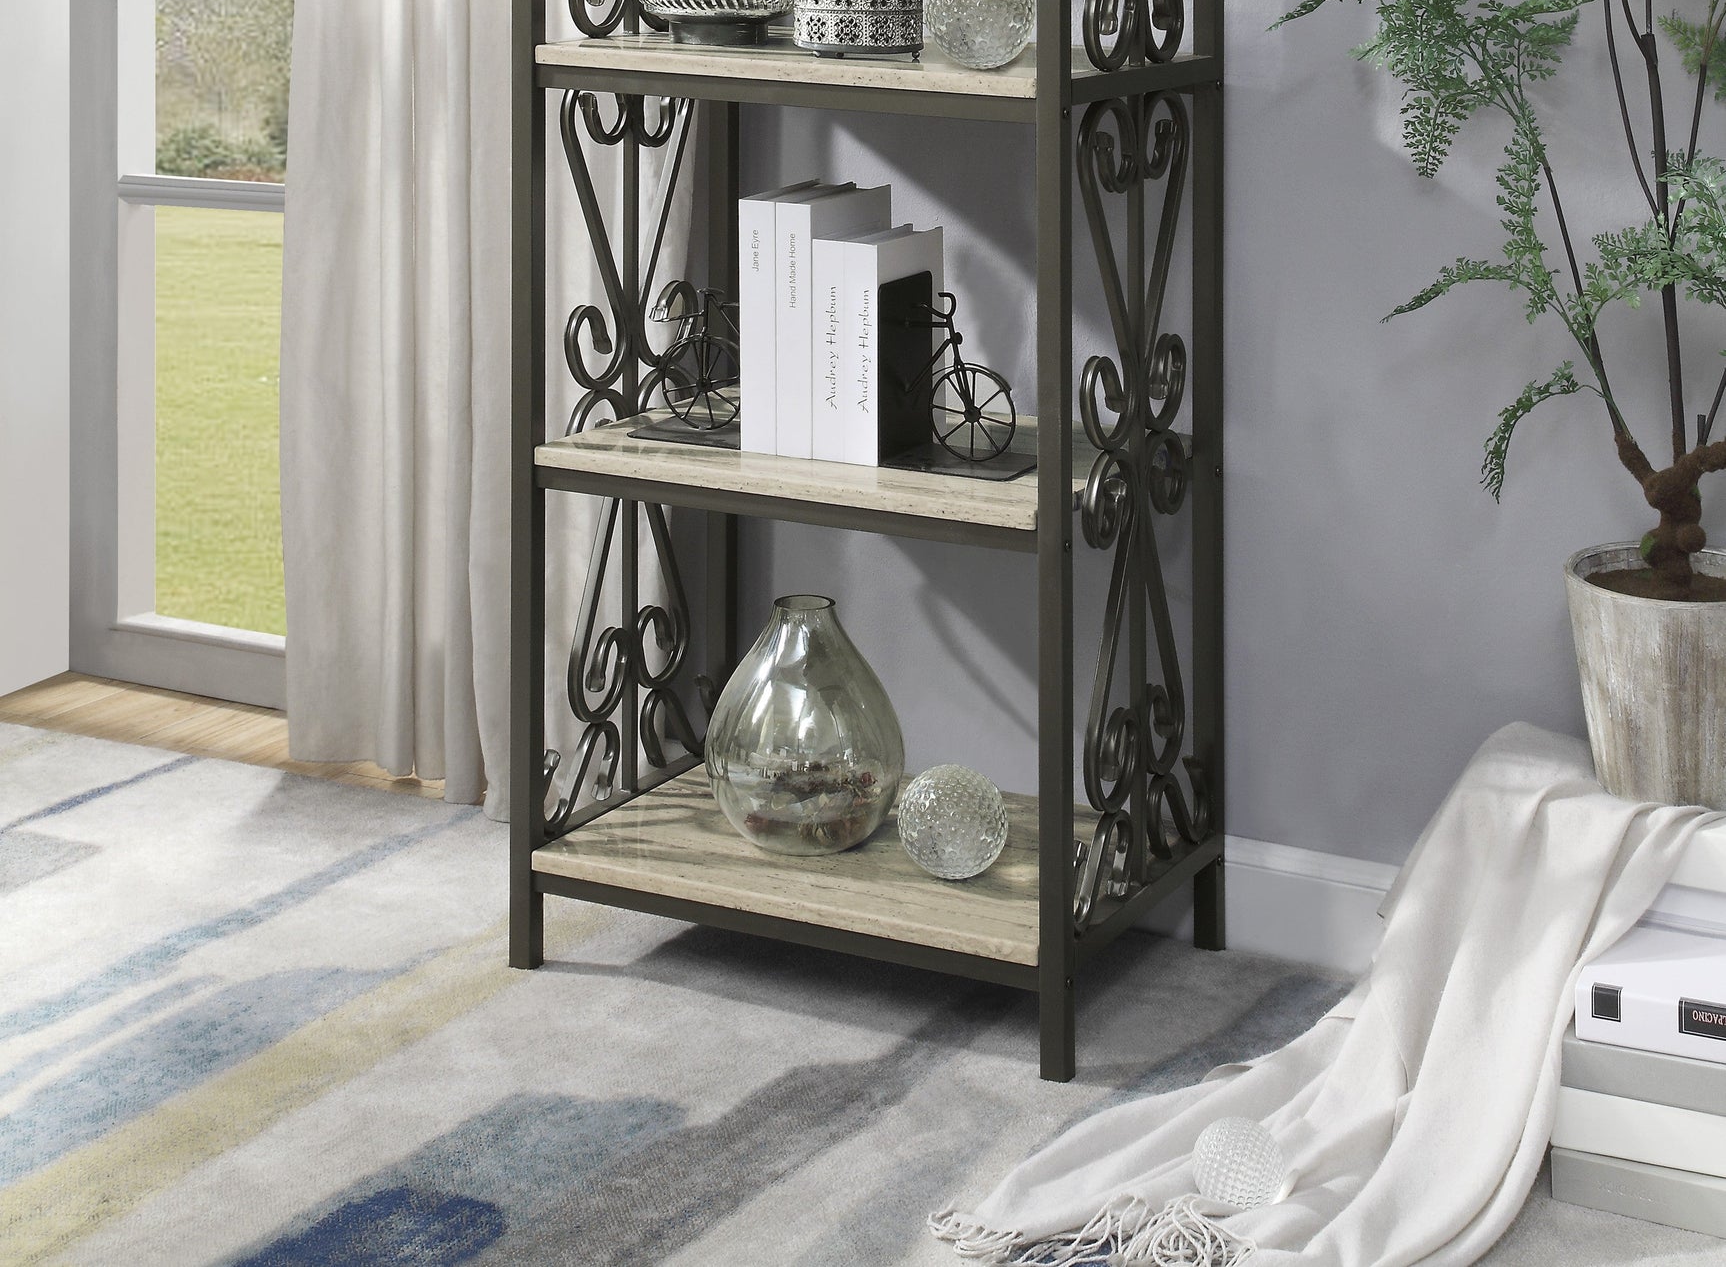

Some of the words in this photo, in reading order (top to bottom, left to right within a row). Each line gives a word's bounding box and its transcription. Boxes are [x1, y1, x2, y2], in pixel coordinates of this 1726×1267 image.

[751, 229, 761, 249] Eyre
[789, 233, 797, 259] Home
[751, 250, 760, 272] Jane
[789, 260, 797, 284] Made
[789, 285, 797, 308] Hand
[825, 351, 839, 410] Audrey
[857, 354, 871, 413] Audrey
